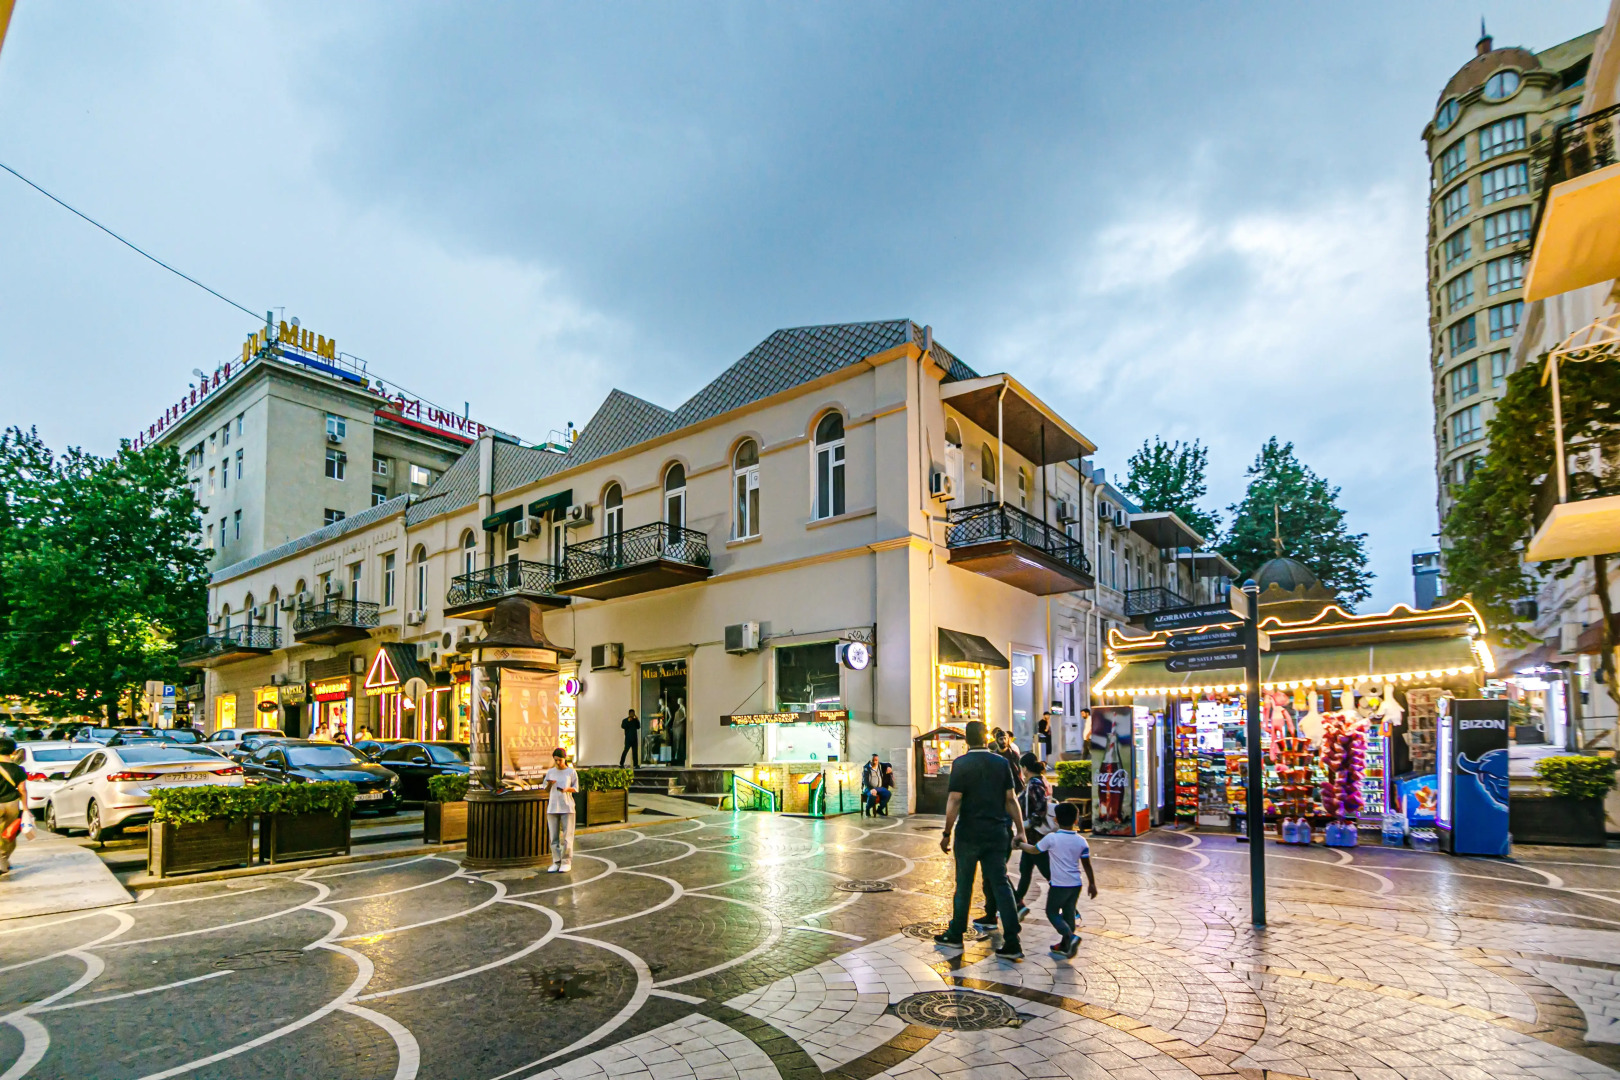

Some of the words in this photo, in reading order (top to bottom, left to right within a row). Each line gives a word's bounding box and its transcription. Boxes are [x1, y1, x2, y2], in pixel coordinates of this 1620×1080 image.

[279, 320, 335, 360] MUM
[428, 407, 491, 435] UNİVER
[1154, 611, 1202, 622] AZƏRBAYCAN
[643, 669, 658, 679] Mia
[660, 667, 687, 678] Amore
[165, 686, 174, 695] P
[1459, 719, 1506, 730] BIZON
[519, 725, 552, 737] BAKI
